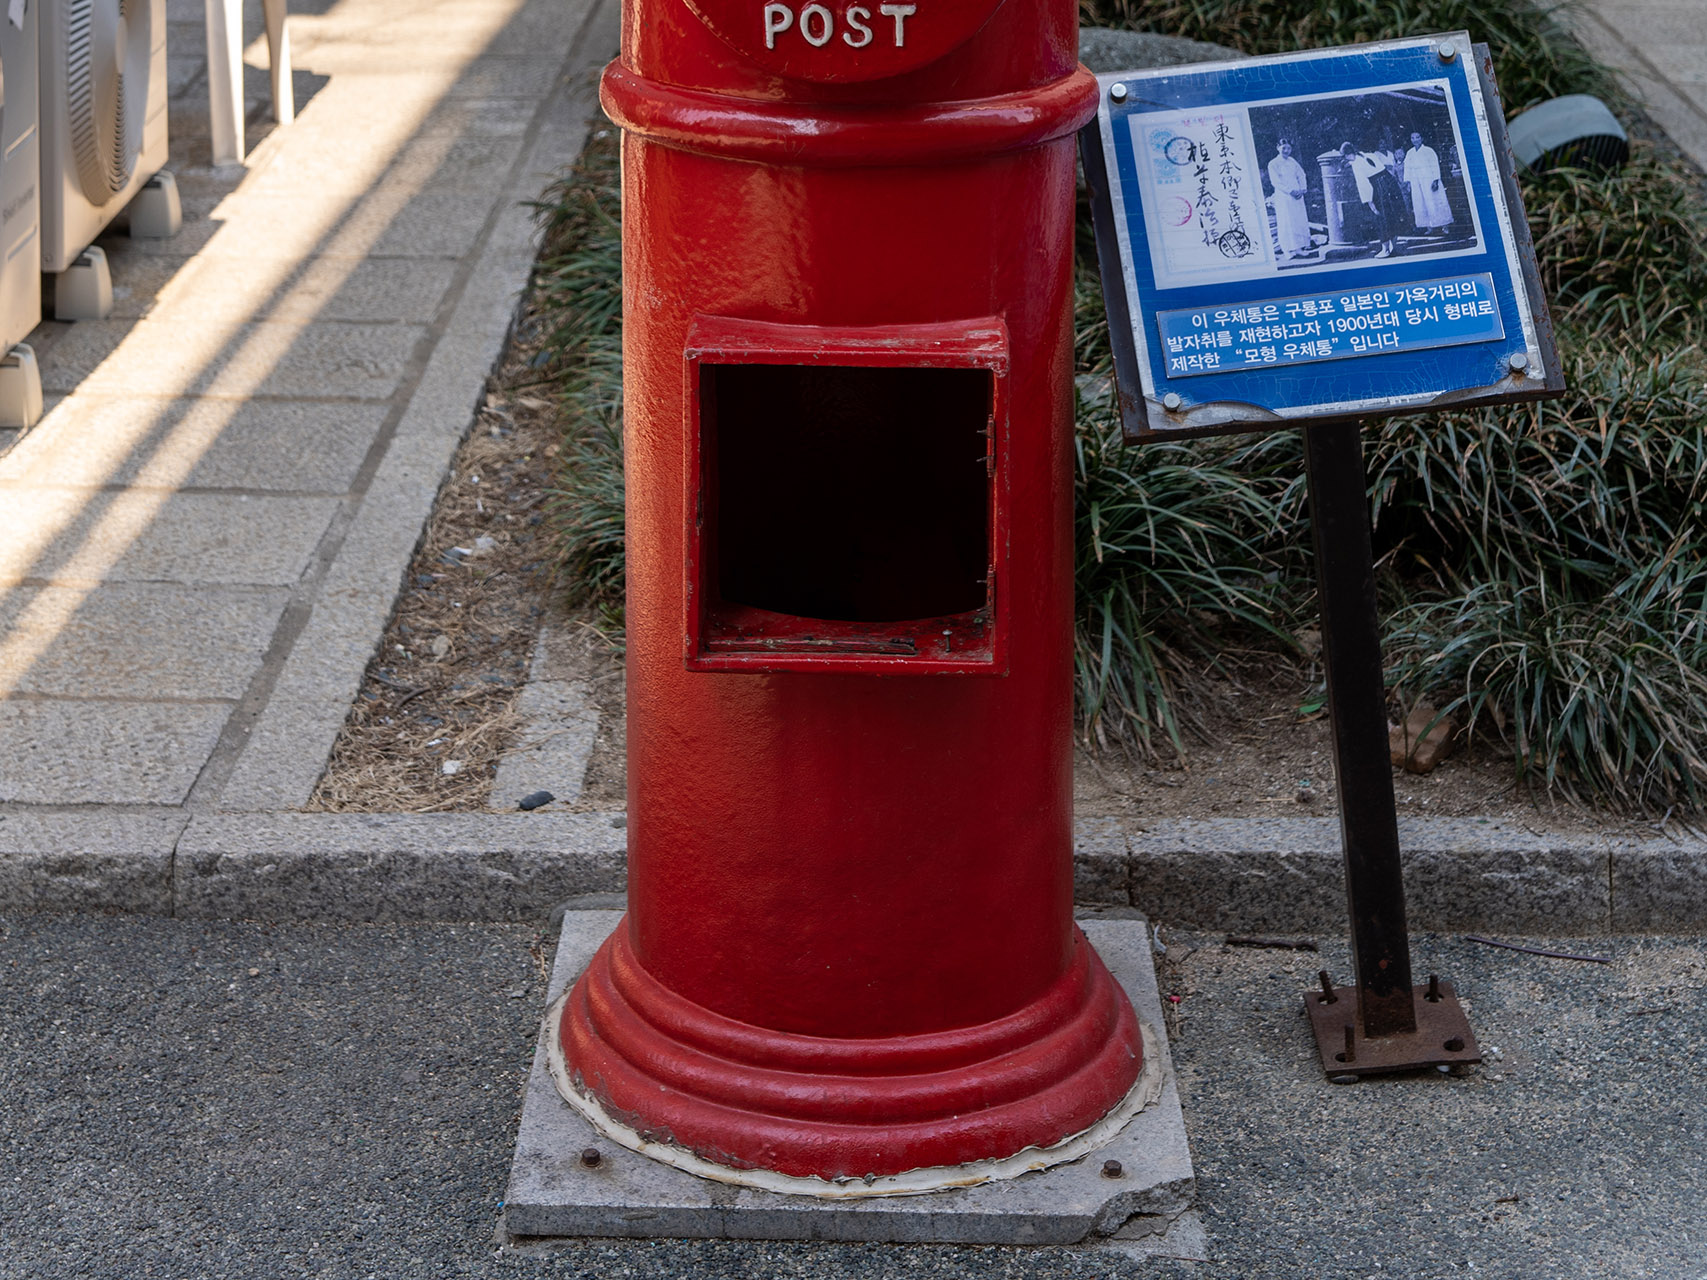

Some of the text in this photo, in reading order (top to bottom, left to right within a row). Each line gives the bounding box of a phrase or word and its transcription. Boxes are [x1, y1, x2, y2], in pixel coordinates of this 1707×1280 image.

[764, 2, 917, 50] POST
[1167, 300, 1495, 353] 발자취를 재현하고자 1900년대 당시 형태로
[1192, 280, 1478, 328] 이 우체통은 구룡포 일본인 가옥거리의
[1171, 352, 1220, 372] 제작한
[1349, 331, 1400, 353] 입니다
